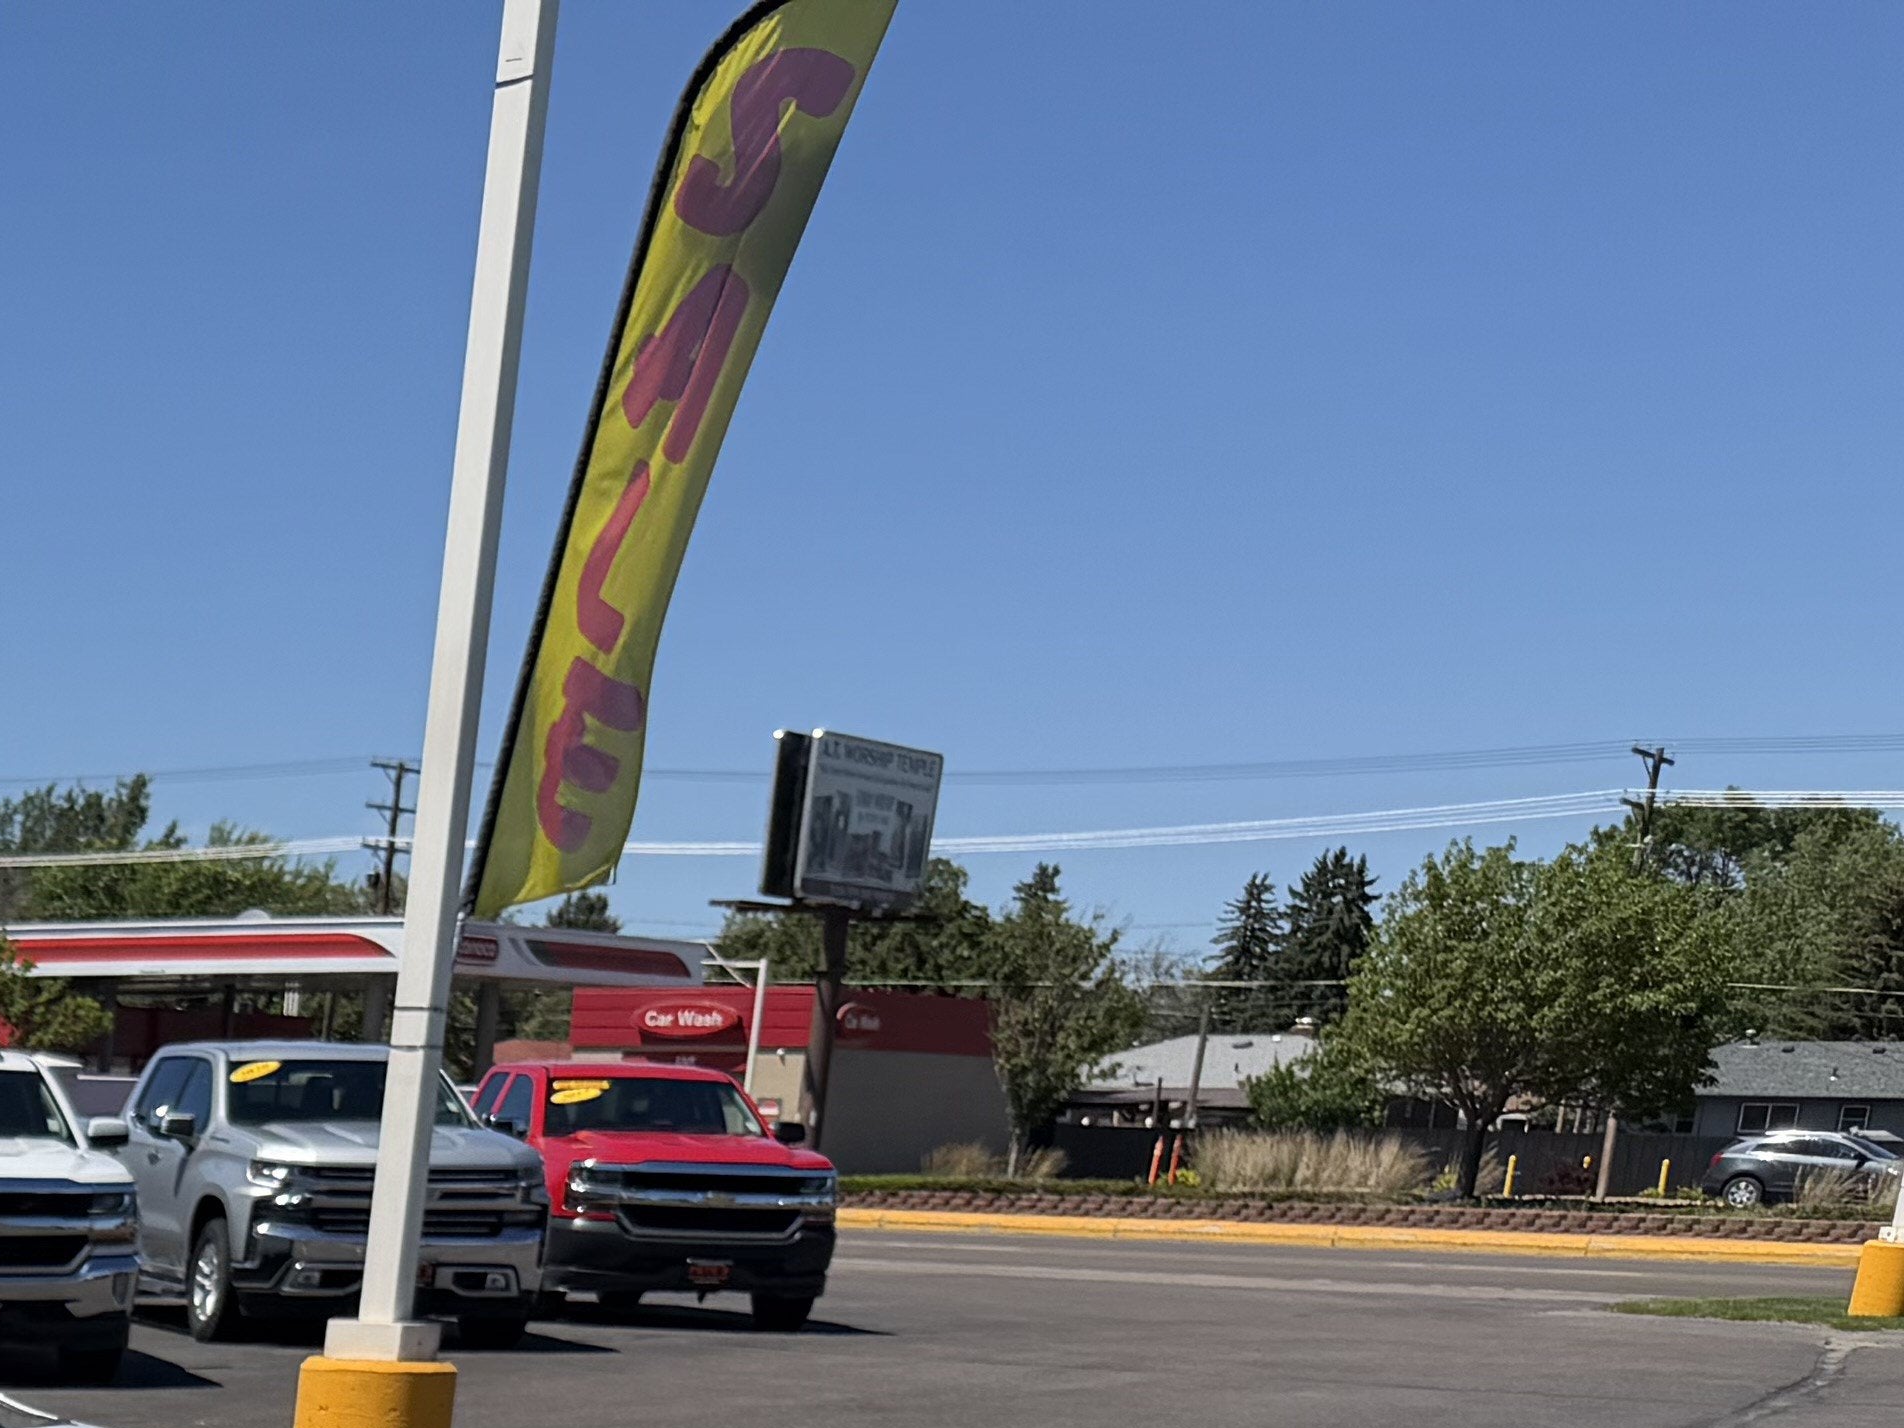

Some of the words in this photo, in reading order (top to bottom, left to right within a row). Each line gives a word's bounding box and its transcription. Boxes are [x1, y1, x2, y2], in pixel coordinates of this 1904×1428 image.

[535, 46, 856, 854] SALE
[643, 1009, 674, 1028] Car
[677, 1008, 724, 1028] Wash
